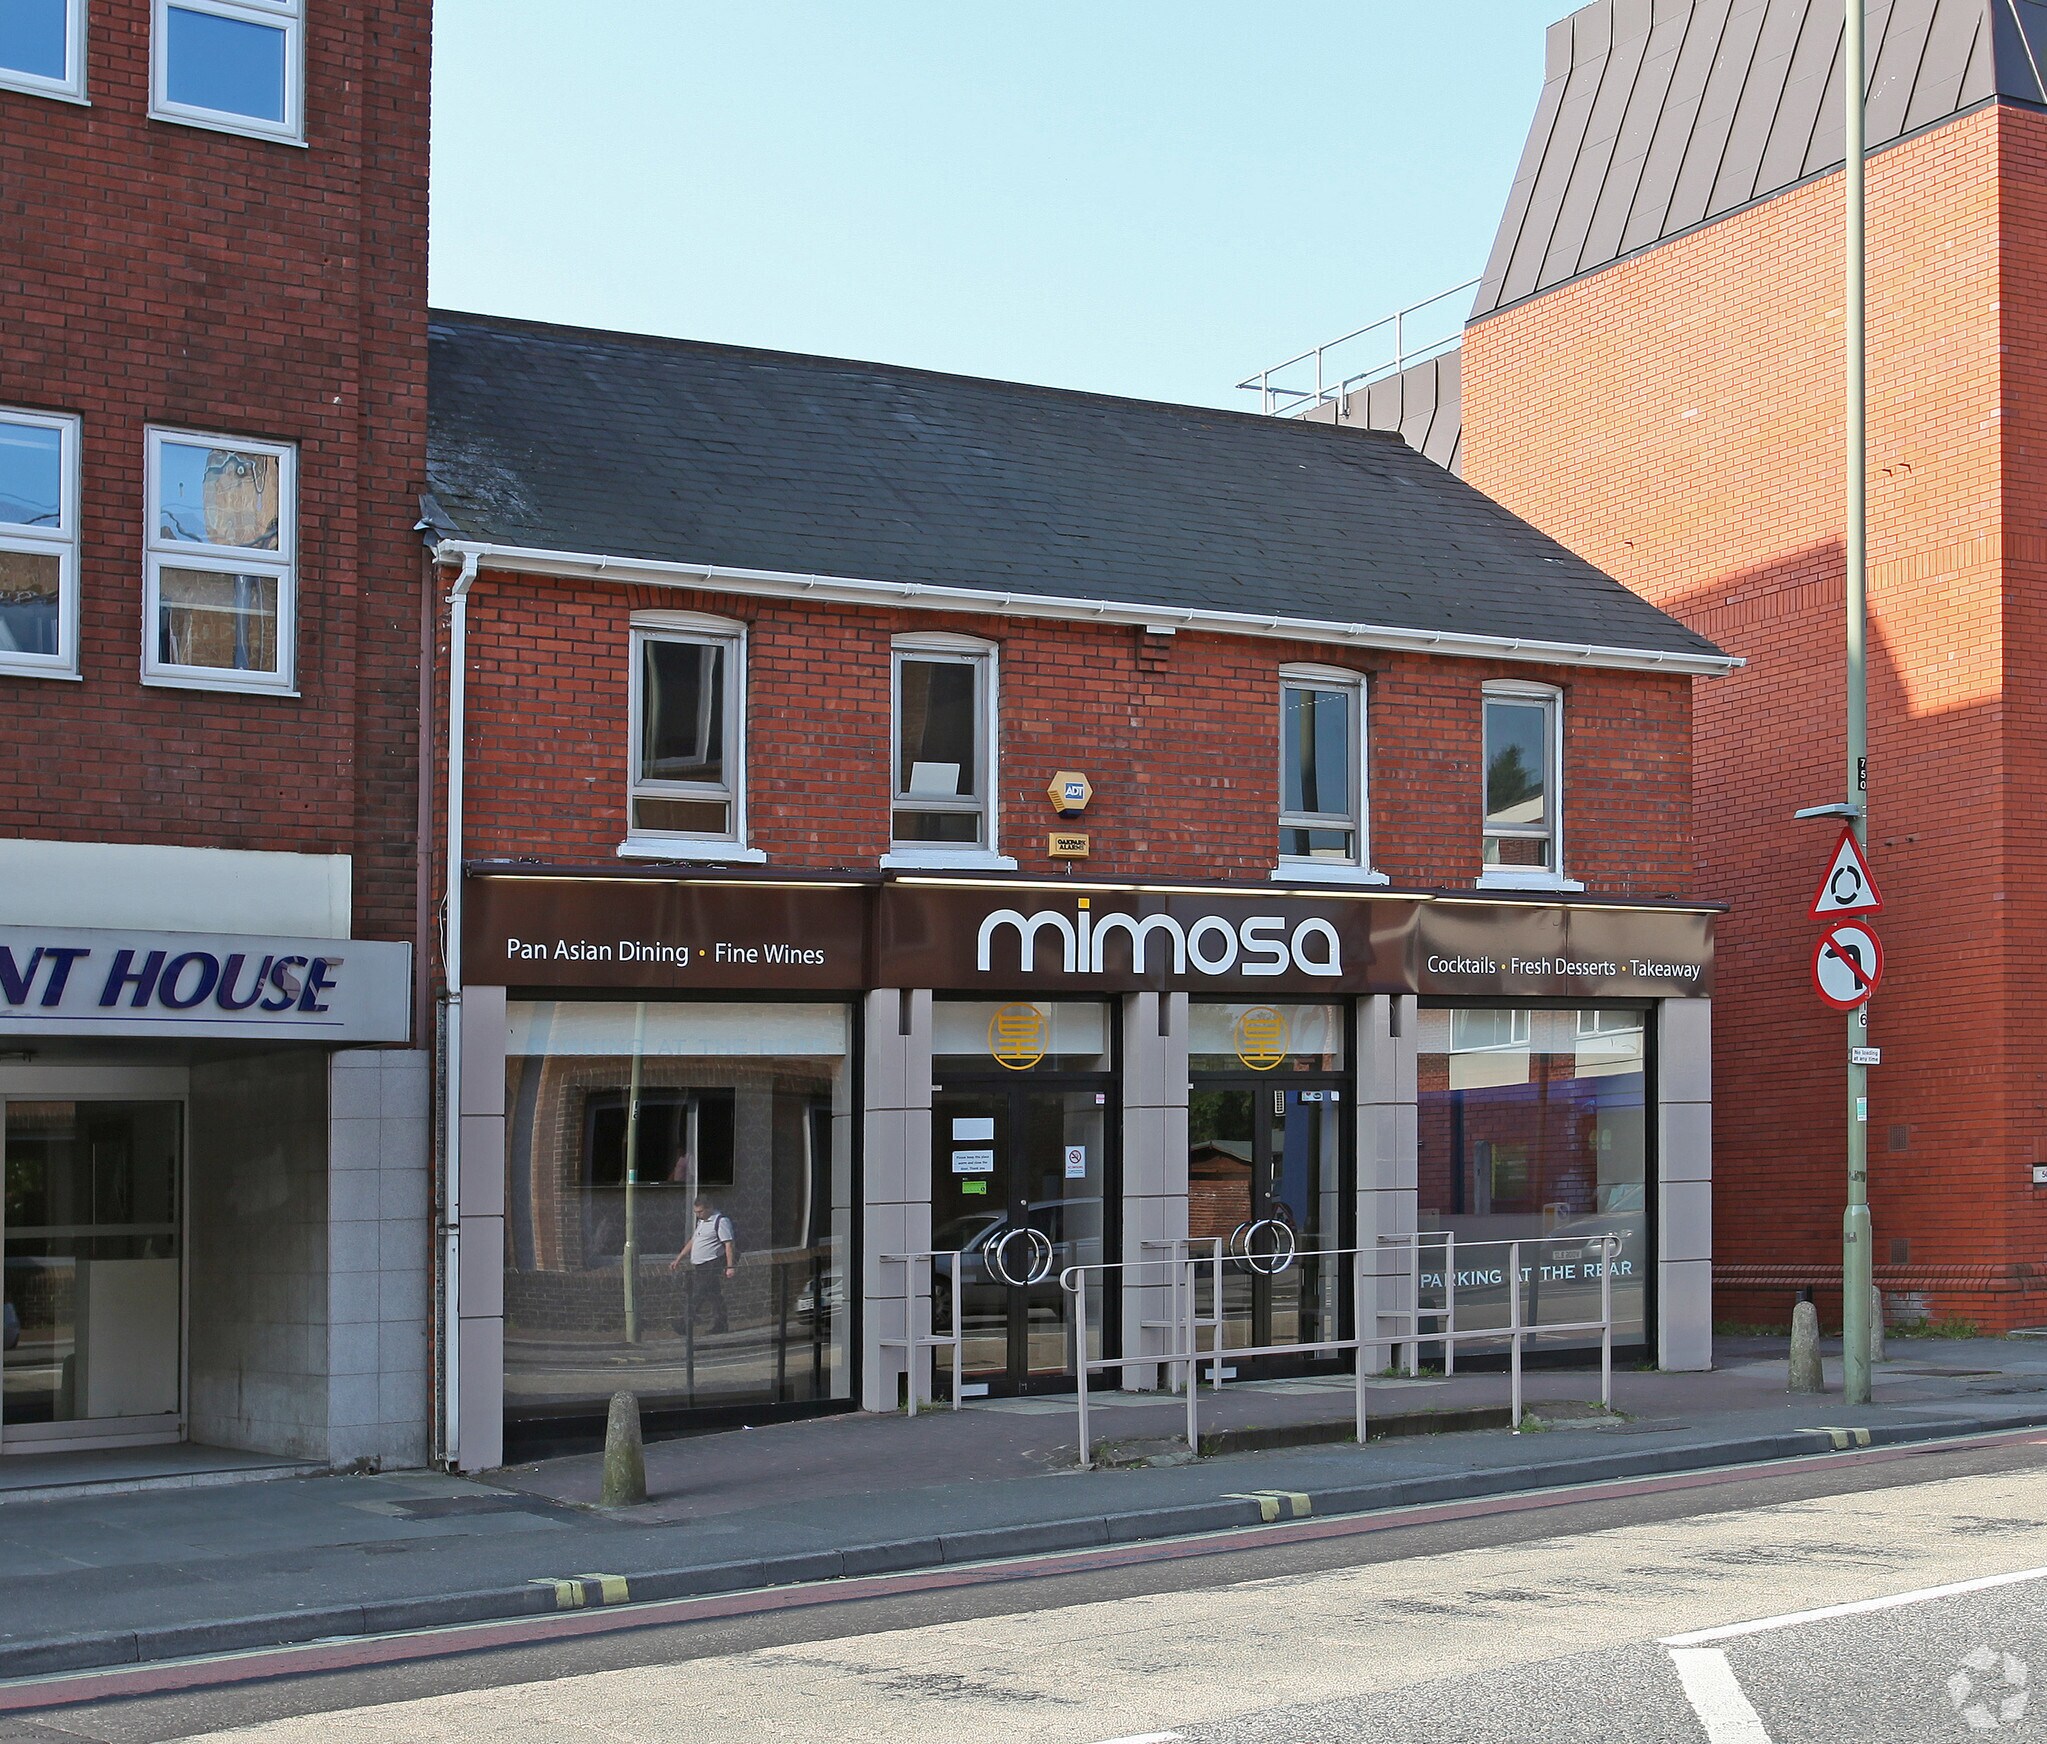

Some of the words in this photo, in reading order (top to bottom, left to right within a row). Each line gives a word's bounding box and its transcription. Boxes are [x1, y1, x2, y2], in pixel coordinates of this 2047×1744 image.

[1065, 785, 1084, 797] ADT
[977, 897, 1343, 976] mimosa
[507, 938, 547, 960] Pan
[553, 940, 612, 962] Asian
[618, 940, 689, 968] Dining
[715, 942, 758, 963] Fine
[764, 943, 825, 965] Wines
[0, 946, 91, 1007] NT
[99, 949, 344, 1012] HOUSE
[1427, 955, 1496, 975] Cocktails
[1510, 957, 1551, 975] Fresh
[1554, 958, 1616, 976] Desserts
[1629, 958, 1701, 981] Takeaway
[1540, 1264, 1575, 1280] THE
